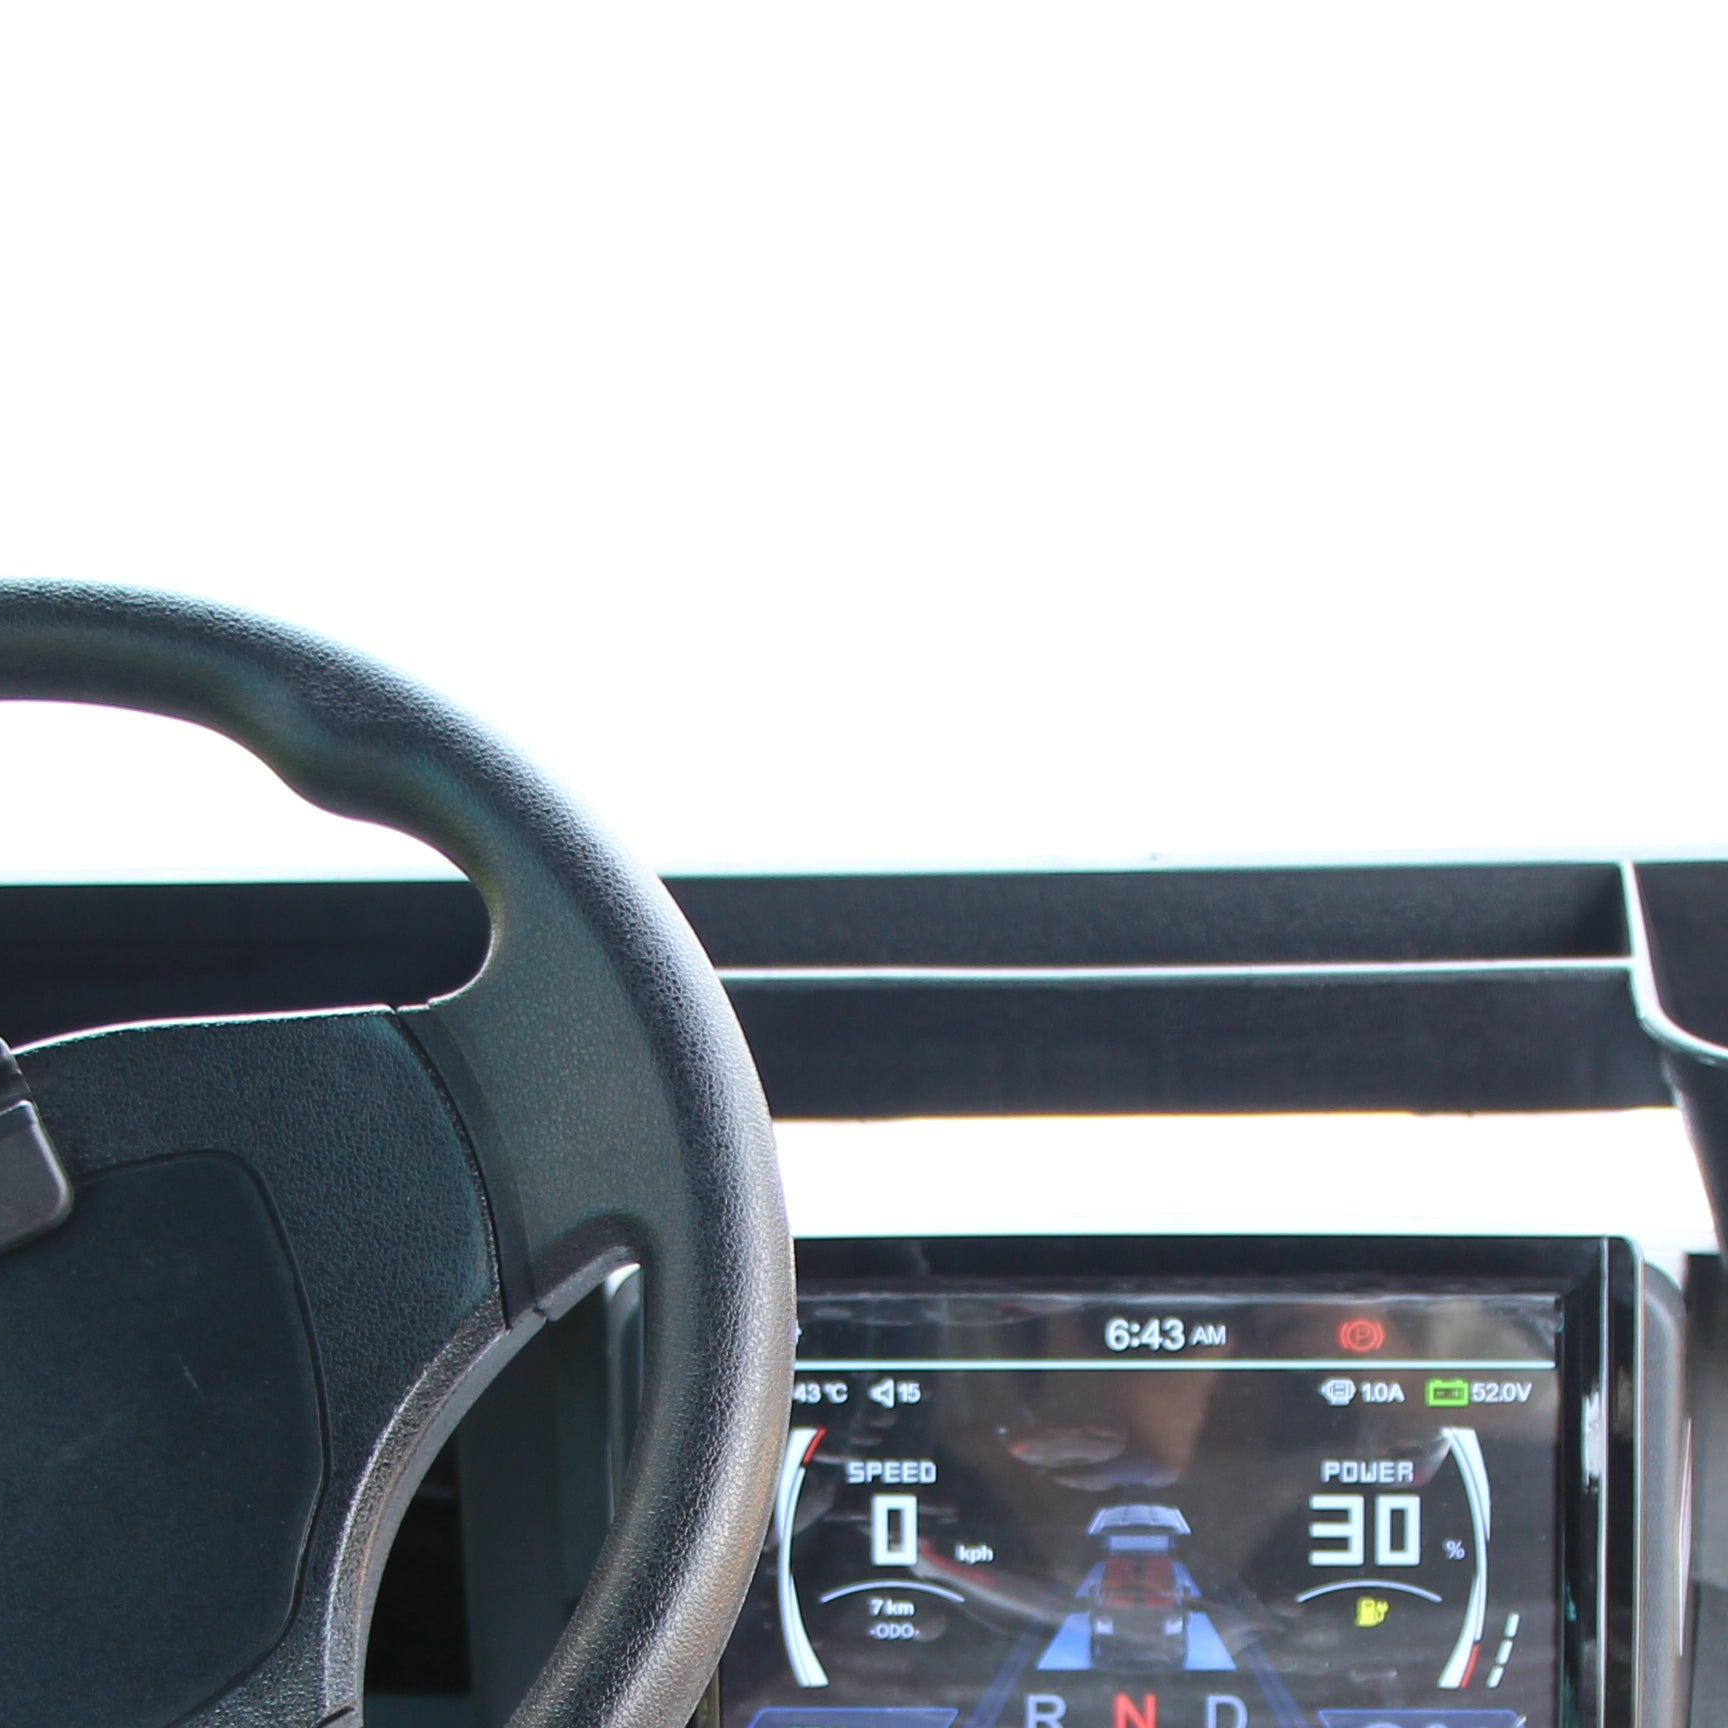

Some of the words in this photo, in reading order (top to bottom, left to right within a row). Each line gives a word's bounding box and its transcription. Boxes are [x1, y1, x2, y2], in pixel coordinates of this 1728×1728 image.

[1105, 1317, 1186, 1352] 6:43
[1190, 1324, 1227, 1346] AM
[896, 1382, 921, 1403] 15
[1361, 1381, 1405, 1403] 1.0A
[1471, 1381, 1533, 1403] 52.0V
[845, 1459, 937, 1484] SPEED
[1321, 1460, 1414, 1484] POWER
[871, 1494, 918, 1567] 0
[1309, 1494, 1421, 1566] 30
[956, 1544, 994, 1565] kph
[1444, 1539, 1466, 1560] %
